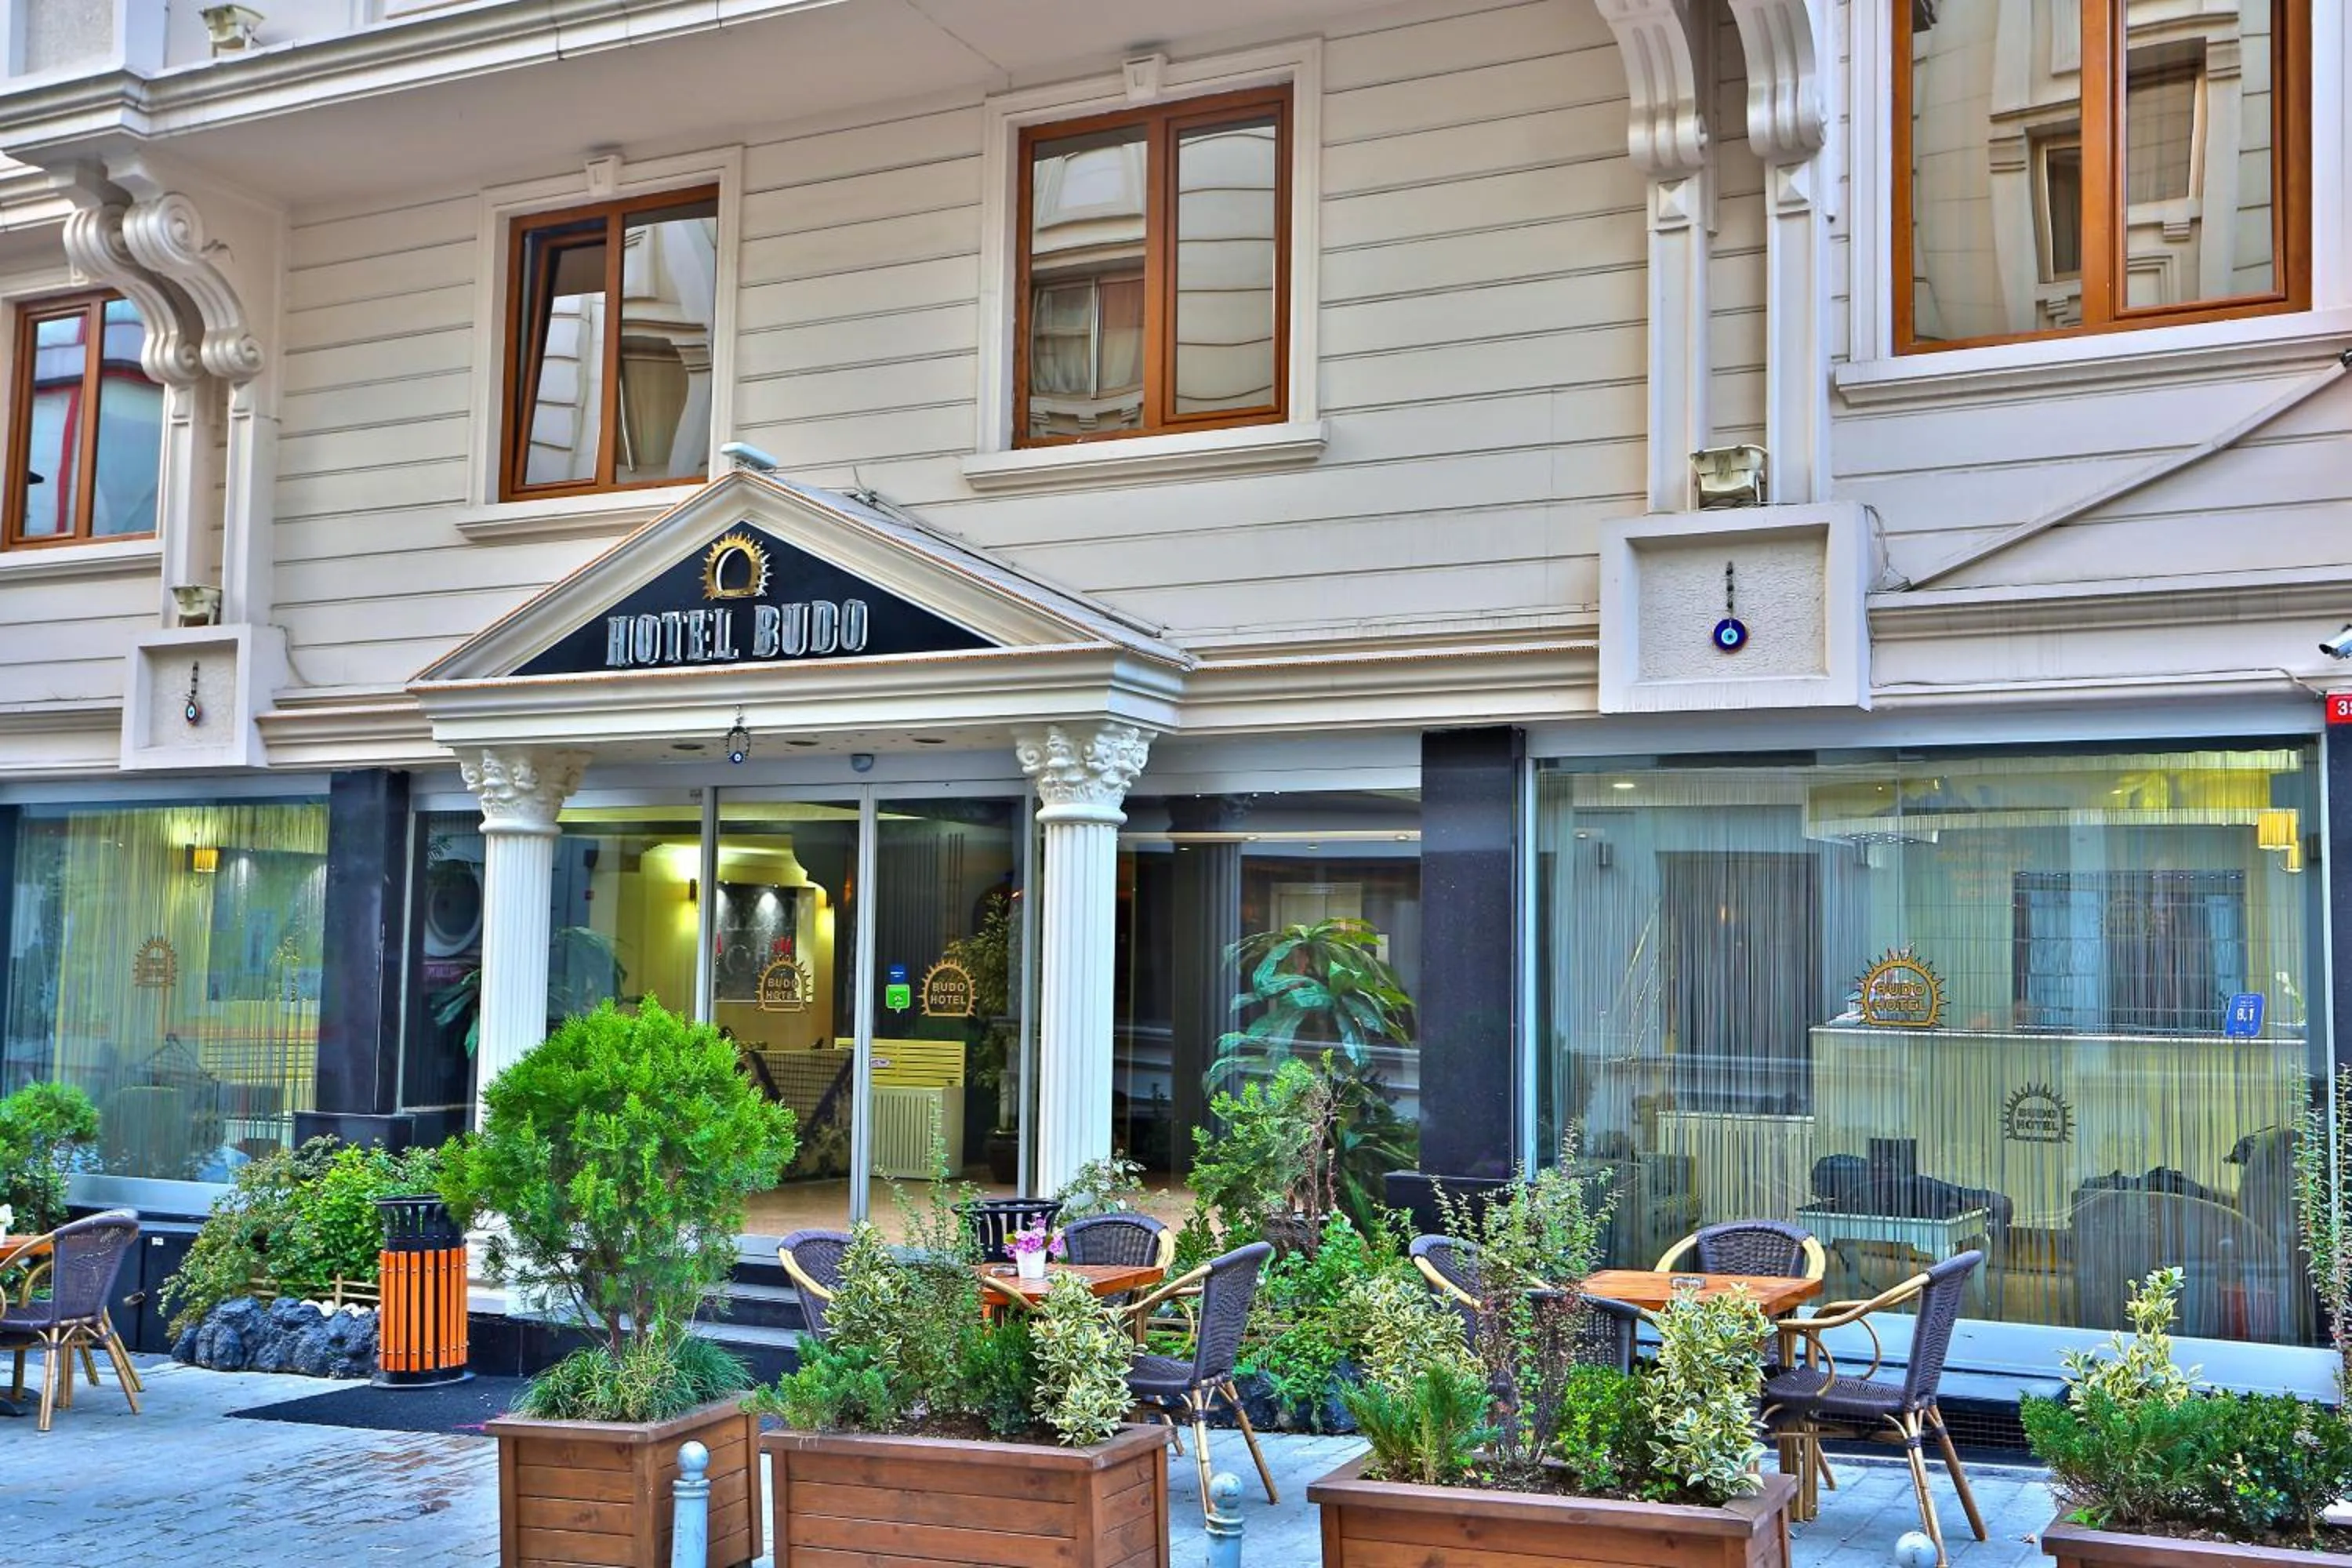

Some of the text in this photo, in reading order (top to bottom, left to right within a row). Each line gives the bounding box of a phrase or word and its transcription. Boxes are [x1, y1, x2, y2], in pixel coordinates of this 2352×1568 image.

[606, 598, 868, 666] HOTEL BUDO
[2337, 700, 2352, 716] 3
[768, 978, 800, 988] BUDO
[932, 982, 966, 992] BUDO
[930, 994, 967, 1004] HOTEL
[2016, 1120, 2060, 1131] HOTEL
